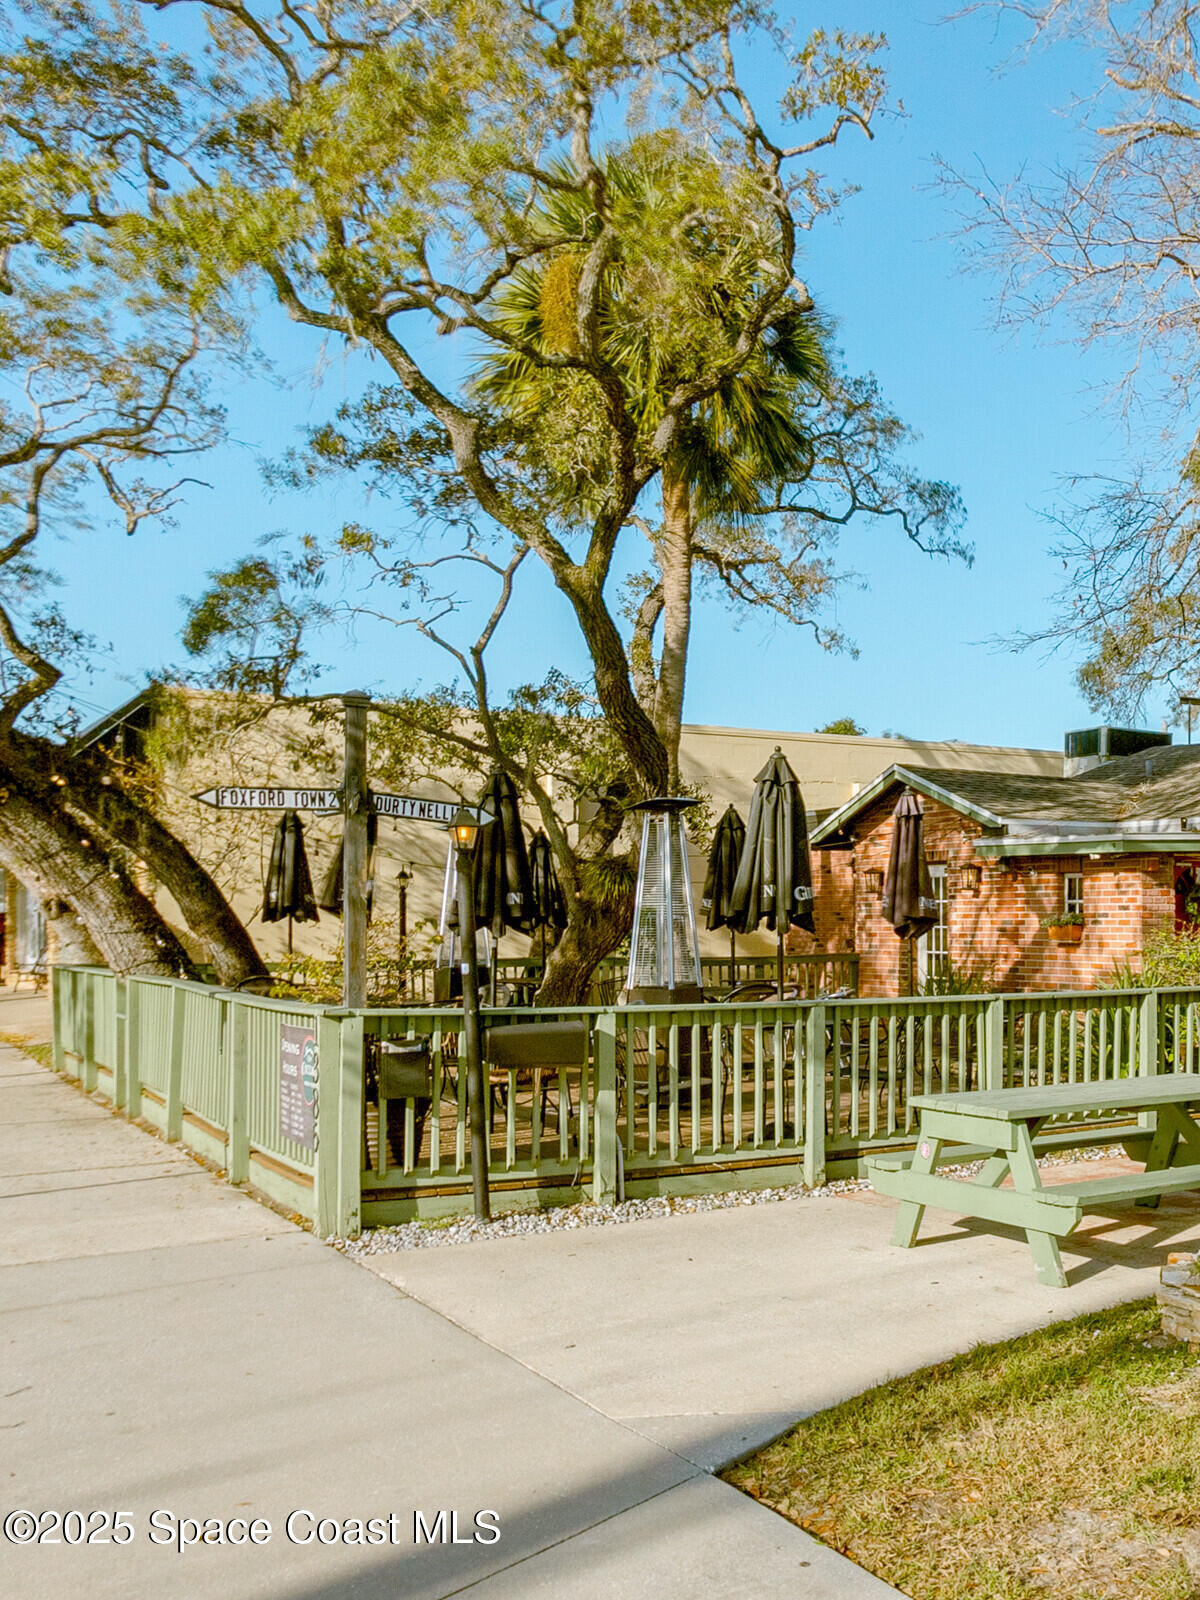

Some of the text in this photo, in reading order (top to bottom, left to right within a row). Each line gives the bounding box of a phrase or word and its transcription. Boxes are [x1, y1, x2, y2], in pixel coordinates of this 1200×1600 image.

[220, 789, 285, 806] FOXFORD
[294, 791, 326, 807] TOWN
[375, 797, 470, 821] DURTY NELLI
